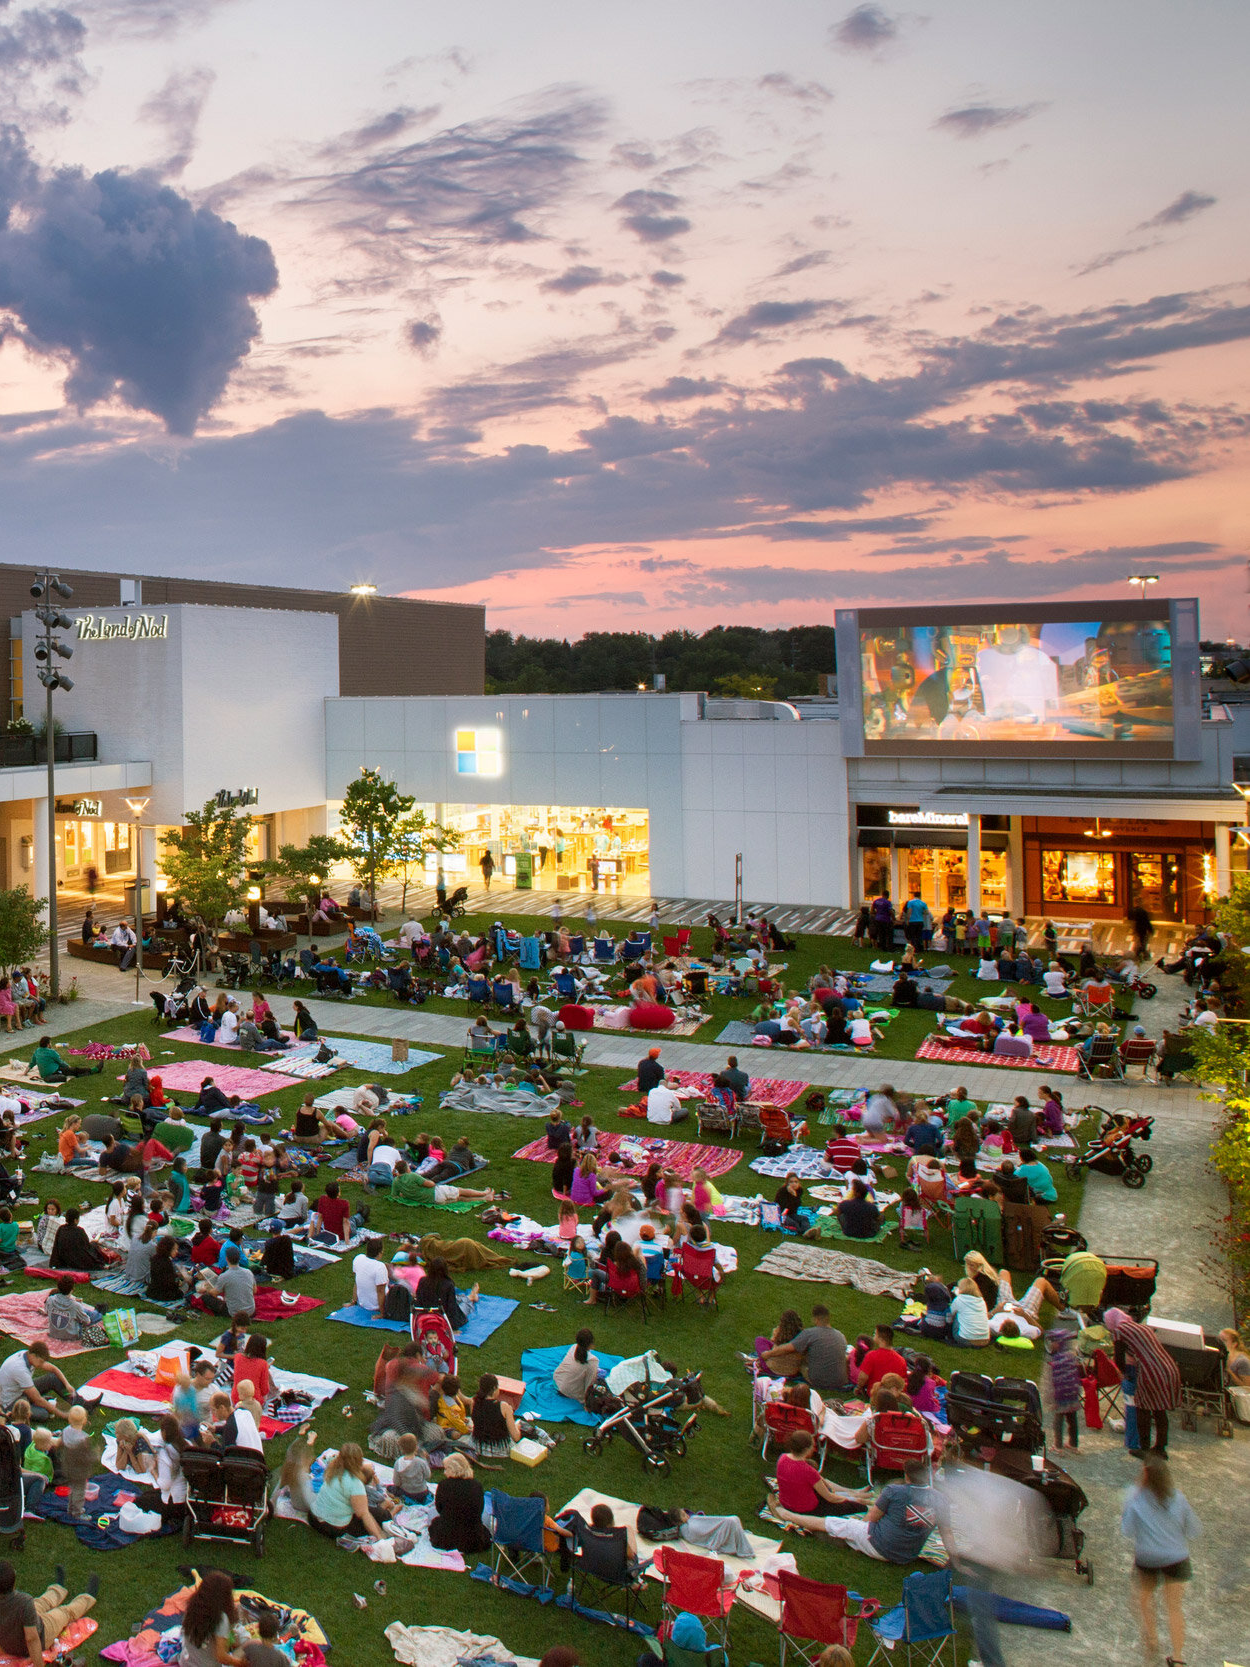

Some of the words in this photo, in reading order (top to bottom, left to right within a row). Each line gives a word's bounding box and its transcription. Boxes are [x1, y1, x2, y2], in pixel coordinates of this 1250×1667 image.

[74, 615, 98, 639] The
[97, 616, 130, 639] Land
[129, 618, 141, 640] of
[138, 614, 168, 638] Nod
[82, 799, 102, 817] Nod
[888, 810, 970, 825] bareMineral
